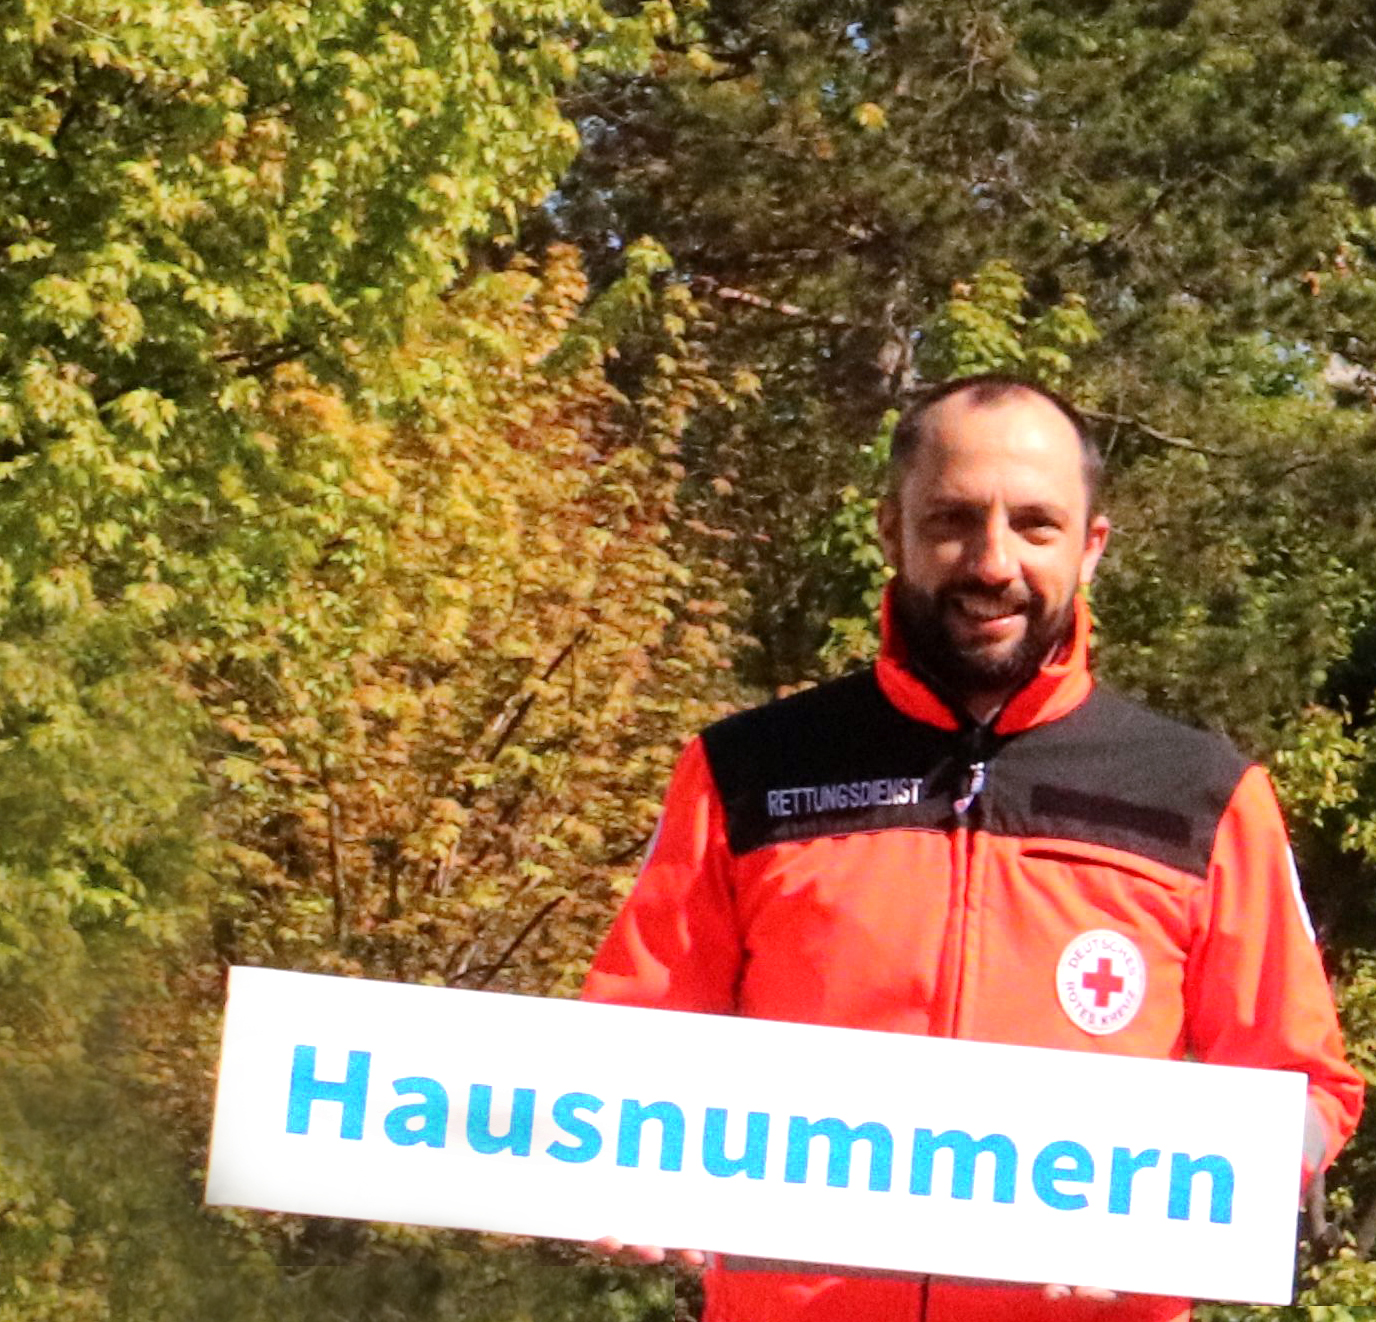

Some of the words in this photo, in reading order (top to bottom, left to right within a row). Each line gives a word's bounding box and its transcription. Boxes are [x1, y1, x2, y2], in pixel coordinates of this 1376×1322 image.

[767, 777, 924, 817] RETTUNGSDIENST
[1068, 938, 1136, 976] DEUTSCHES
[1066, 981, 1096, 1024] ROTES
[285, 1045, 1235, 1225] Hausnummern
